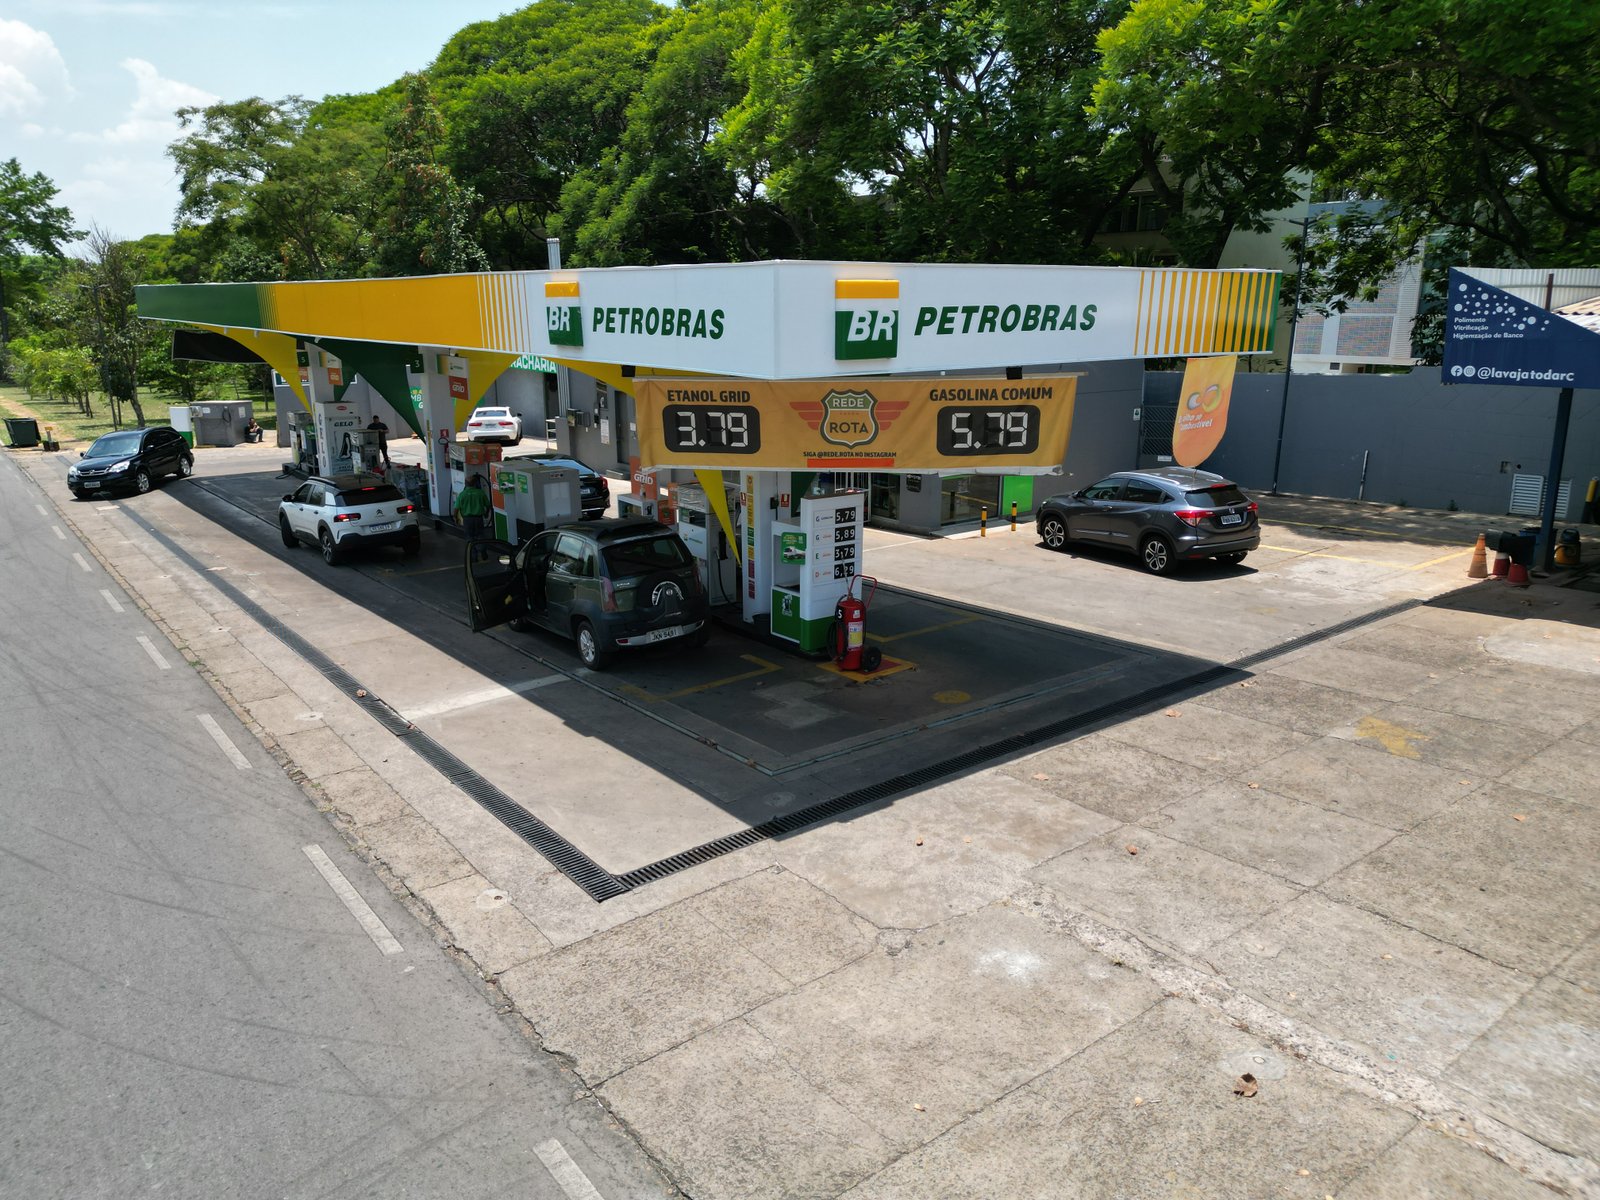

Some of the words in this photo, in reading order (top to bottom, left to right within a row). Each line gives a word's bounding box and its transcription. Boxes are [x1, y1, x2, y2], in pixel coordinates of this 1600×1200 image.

[548, 306, 571, 332] BR
[592, 306, 726, 341] PETROBRAS
[846, 310, 897, 342] BR
[914, 304, 1098, 336] PETROBRAS
[667, 389, 717, 402] ETANOL
[719, 390, 751, 403] GRID
[832, 398, 864, 408] REDE
[929, 388, 999, 402] GASOLINA
[1001, 386, 1053, 400] COMUM
[677, 411, 748, 447] 3.79
[829, 417, 869, 433] ROTA
[951, 411, 1029, 449] 5.79
[836, 510, 856, 522] 5,79
[835, 529, 855, 541] 5,89
